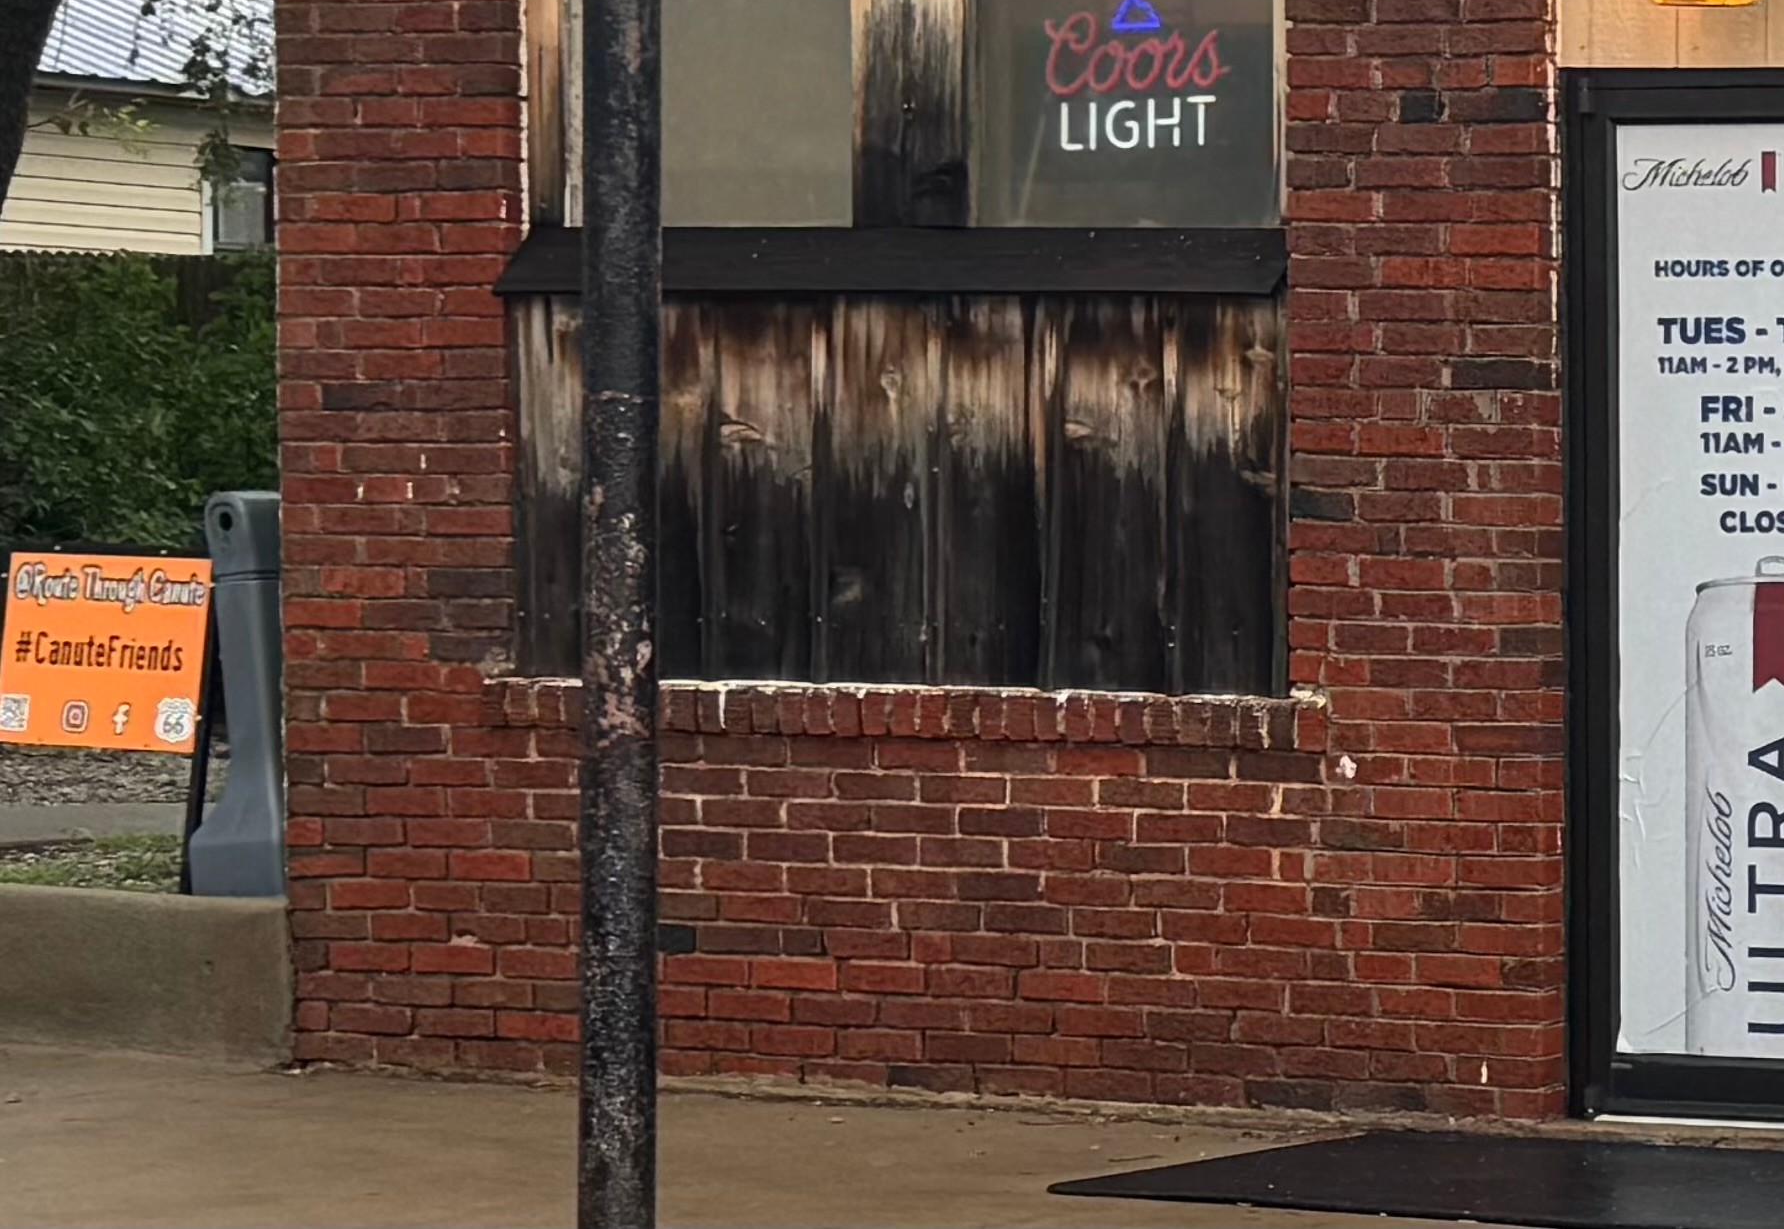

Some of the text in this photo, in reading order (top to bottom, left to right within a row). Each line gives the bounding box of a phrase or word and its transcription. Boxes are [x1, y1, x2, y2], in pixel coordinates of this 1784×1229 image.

[1045, 11, 1231, 96] Coors
[1060, 95, 1216, 150] LIGHT
[1622, 158, 1753, 191] Michelob
[1655, 260, 1729, 277] HOURS
[1735, 260, 1764, 277] OF
[1657, 317, 1745, 344] TUES
[1658, 357, 1707, 374] 11AM
[1726, 357, 1738, 374] 2
[1700, 396, 1754, 423] FRI
[1700, 432, 1764, 454] 11AM
[1700, 474, 1759, 497] SUN
[82, 564, 145, 613] Through
[148, 567, 206, 606] Canute
[15, 631, 183, 672] #CanuteFriends
[163, 714, 184, 735] 66
[1706, 786, 1737, 992] Michelob
